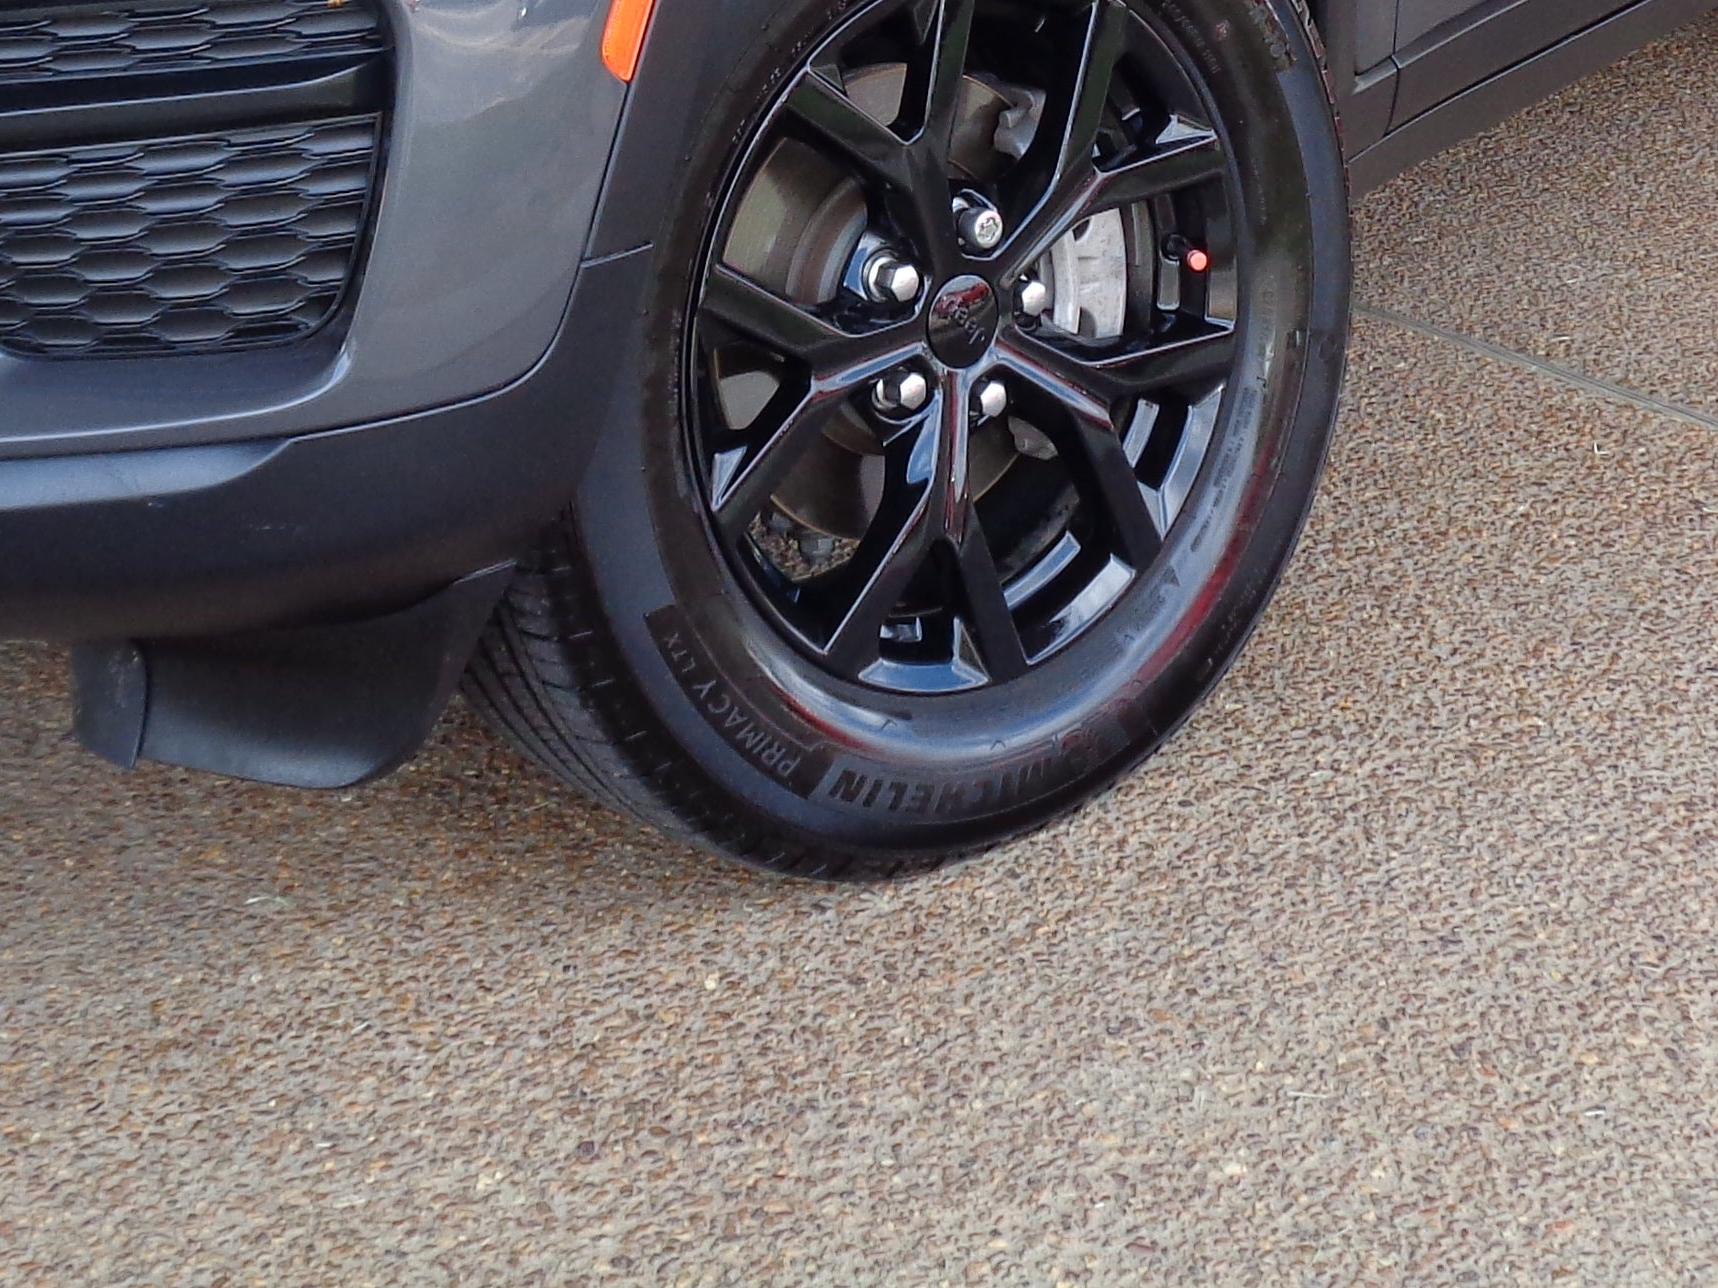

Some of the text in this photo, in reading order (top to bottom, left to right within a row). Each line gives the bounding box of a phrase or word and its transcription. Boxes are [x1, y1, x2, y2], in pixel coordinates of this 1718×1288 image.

[664, 632, 801, 777] PRIMACY LTX
[829, 754, 1054, 815] MICHELIN
